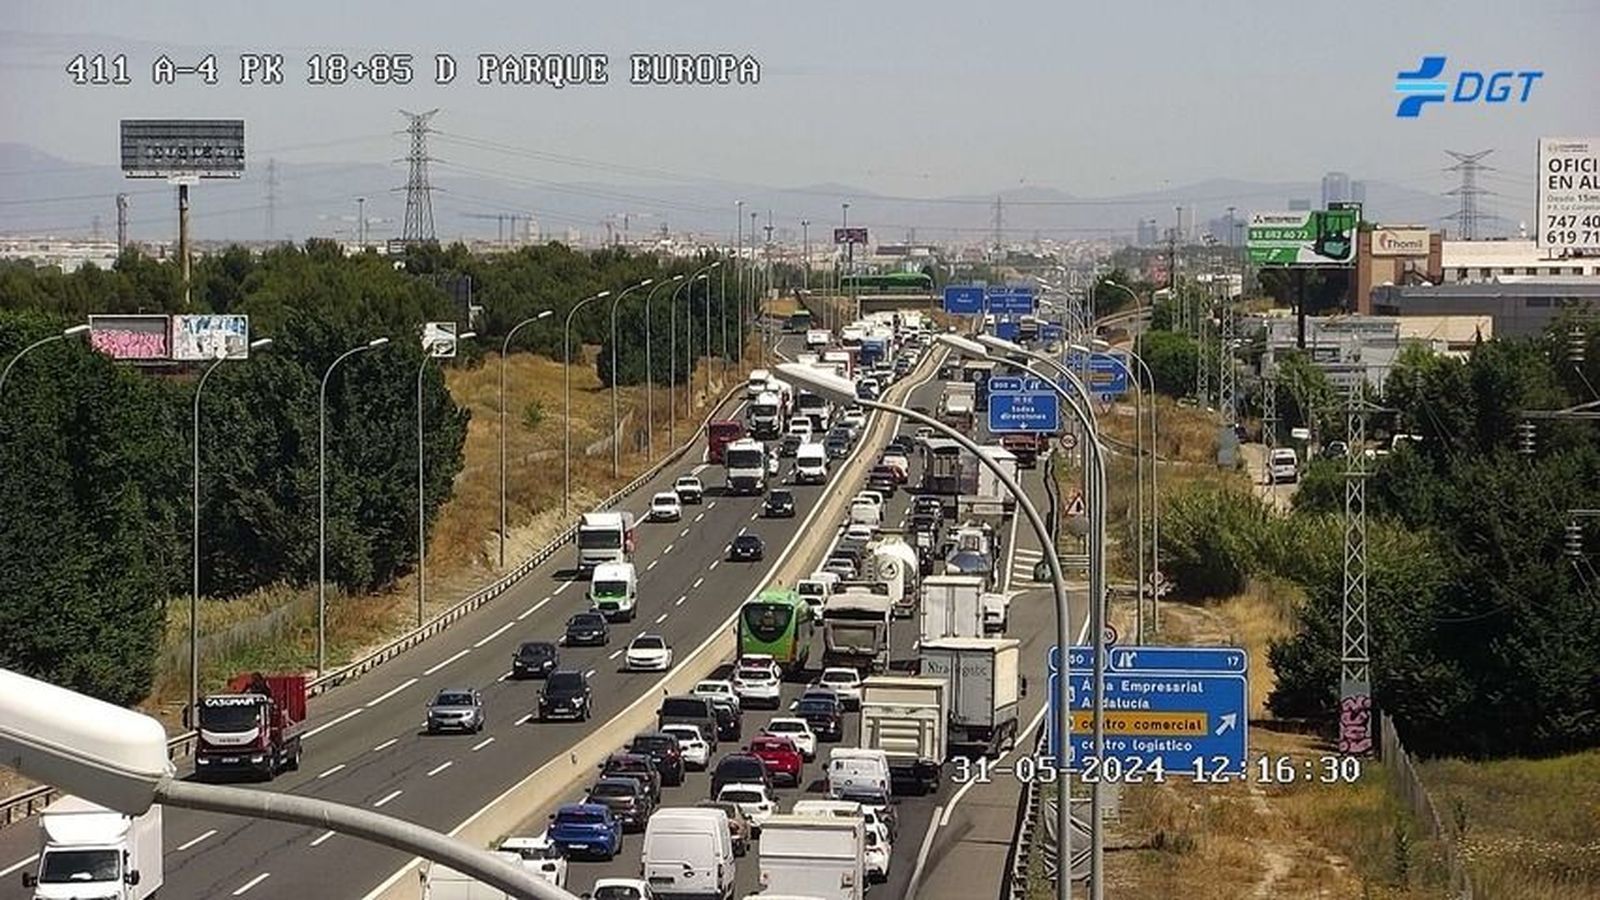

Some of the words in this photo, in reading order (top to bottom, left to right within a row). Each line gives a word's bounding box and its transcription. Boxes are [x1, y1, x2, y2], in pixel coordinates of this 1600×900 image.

[1549, 176, 1573, 190] EN
[1547, 215, 1576, 229] 747
[1582, 215, 1600, 229] 40
[1547, 230, 1577, 244] 619
[1582, 230, 1599, 244] 71
[1227, 656, 1239, 667] 17
[1081, 676, 1114, 691] Áa
[1121, 680, 1204, 694] Empresarial
[1081, 697, 1150, 709] Adalucía
[1081, 719, 1126, 730] cetro
[1133, 719, 1202, 731] comercial
[1081, 740, 1126, 751] cetro
